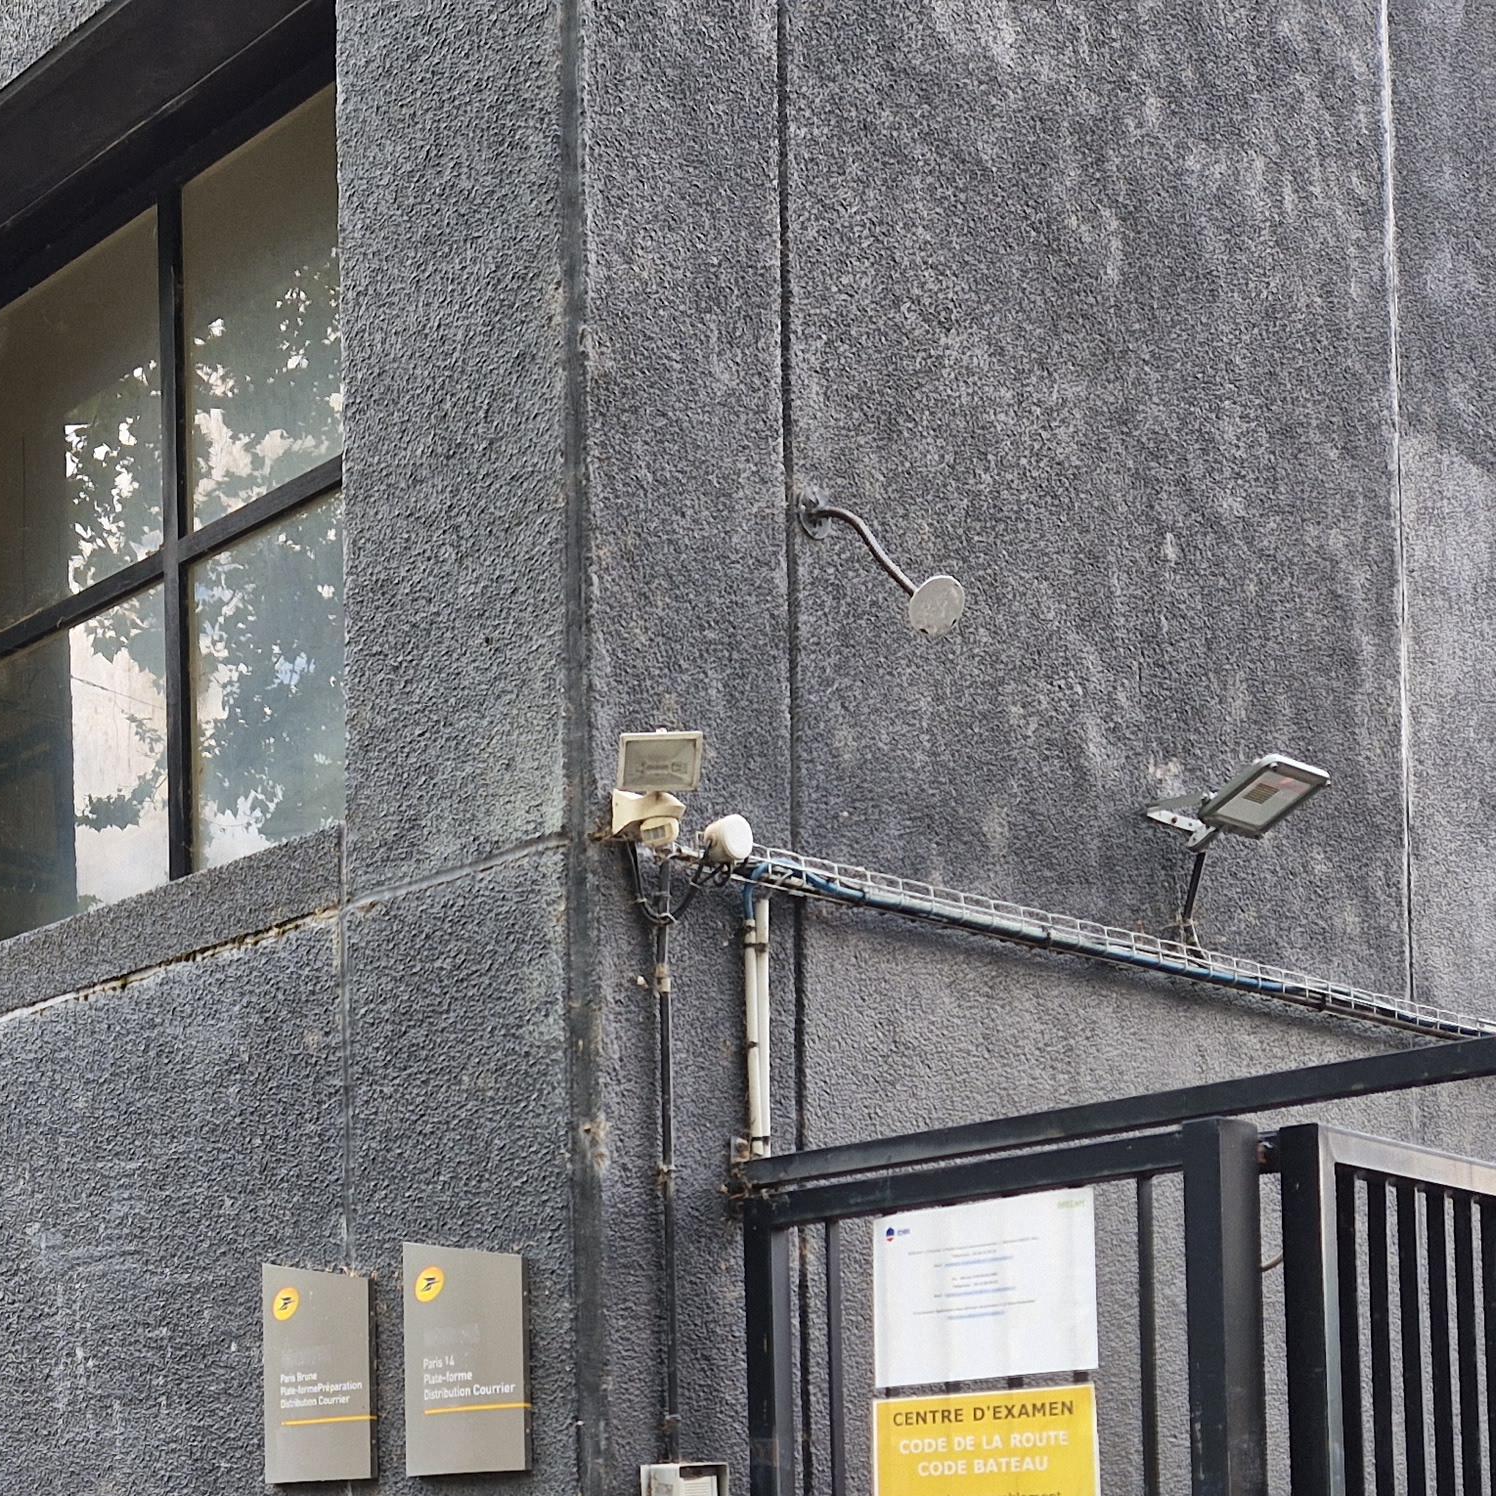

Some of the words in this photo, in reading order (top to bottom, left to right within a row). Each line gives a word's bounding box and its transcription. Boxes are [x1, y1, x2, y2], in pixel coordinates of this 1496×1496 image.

[423, 1356, 443, 1369] Paris
[444, 1355, 455, 1366] 14
[423, 1371, 473, 1385] Plate-forme
[423, 1385, 471, 1400] Distribution
[472, 1381, 517, 1396] Courrier
[280, 1398, 317, 1409] Distribution
[318, 1394, 351, 1406] Courrier
[893, 1407, 964, 1427] CENTRE
[973, 1400, 1075, 1421] D'EXAMEN
[899, 1436, 947, 1455] CODE
[954, 1435, 976, 1450] DE
[982, 1434, 1003, 1449] LA
[1010, 1431, 1069, 1448] ROUTE
[918, 1460, 967, 1477] CODE
[974, 1456, 1049, 1474] BATEAU
